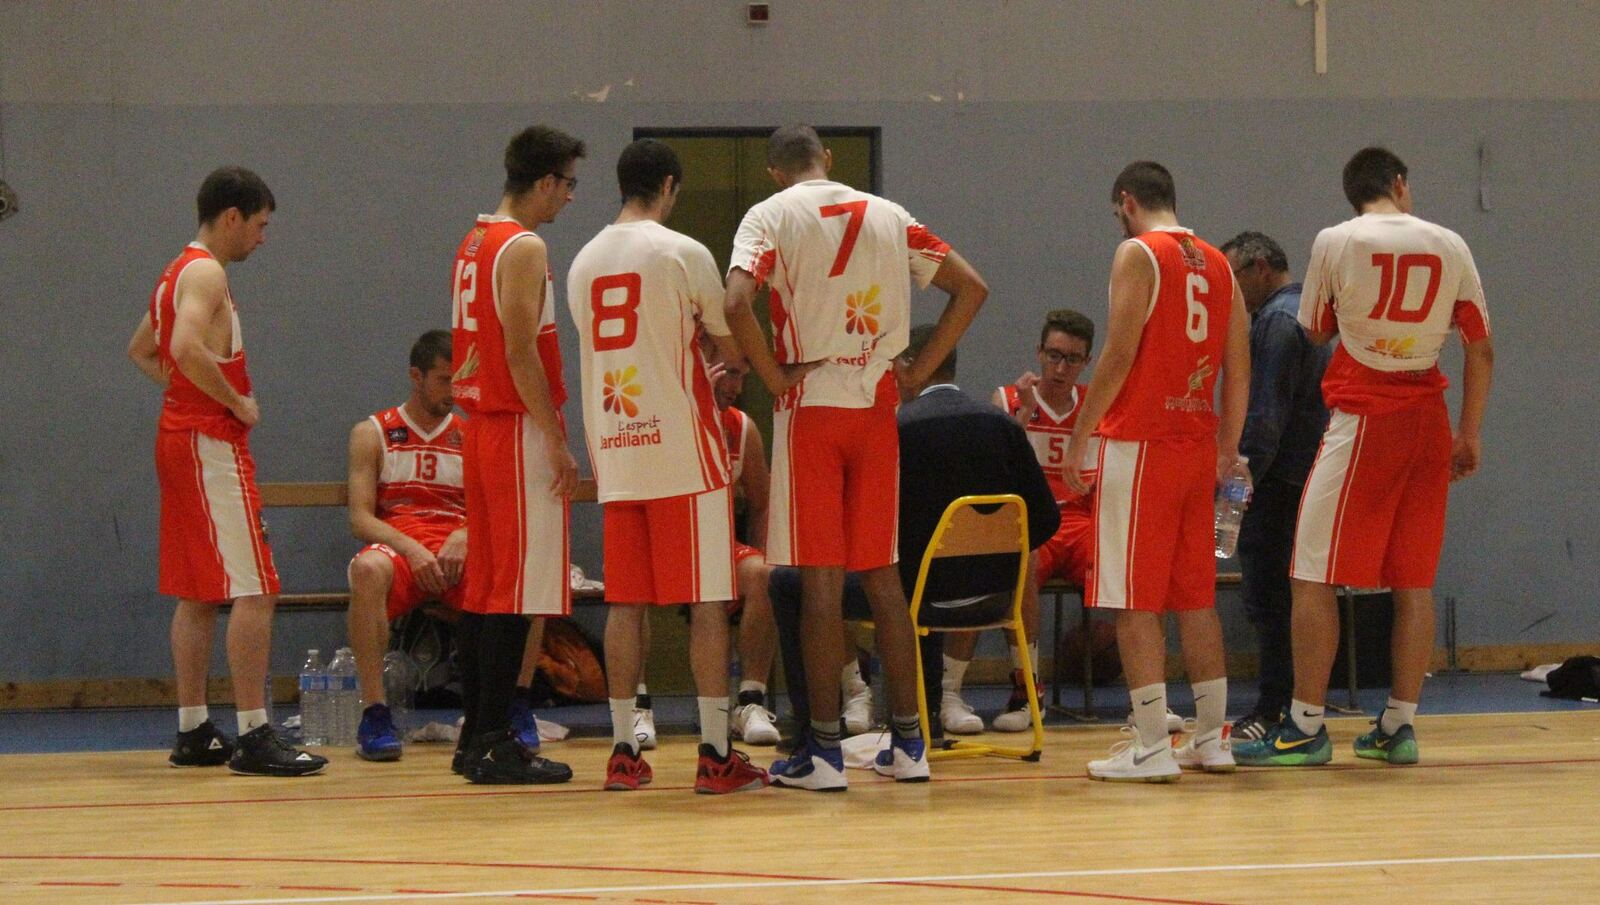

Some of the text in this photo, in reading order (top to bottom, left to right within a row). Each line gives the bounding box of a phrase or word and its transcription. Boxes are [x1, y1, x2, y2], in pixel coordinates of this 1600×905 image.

[819, 200, 868, 278] 7
[452, 259, 478, 331] 12
[591, 272, 641, 352] 8
[1186, 272, 1209, 343] 6
[1368, 253, 1442, 323] 10
[416, 453, 437, 481] 13
[1048, 437, 1064, 464] 5
